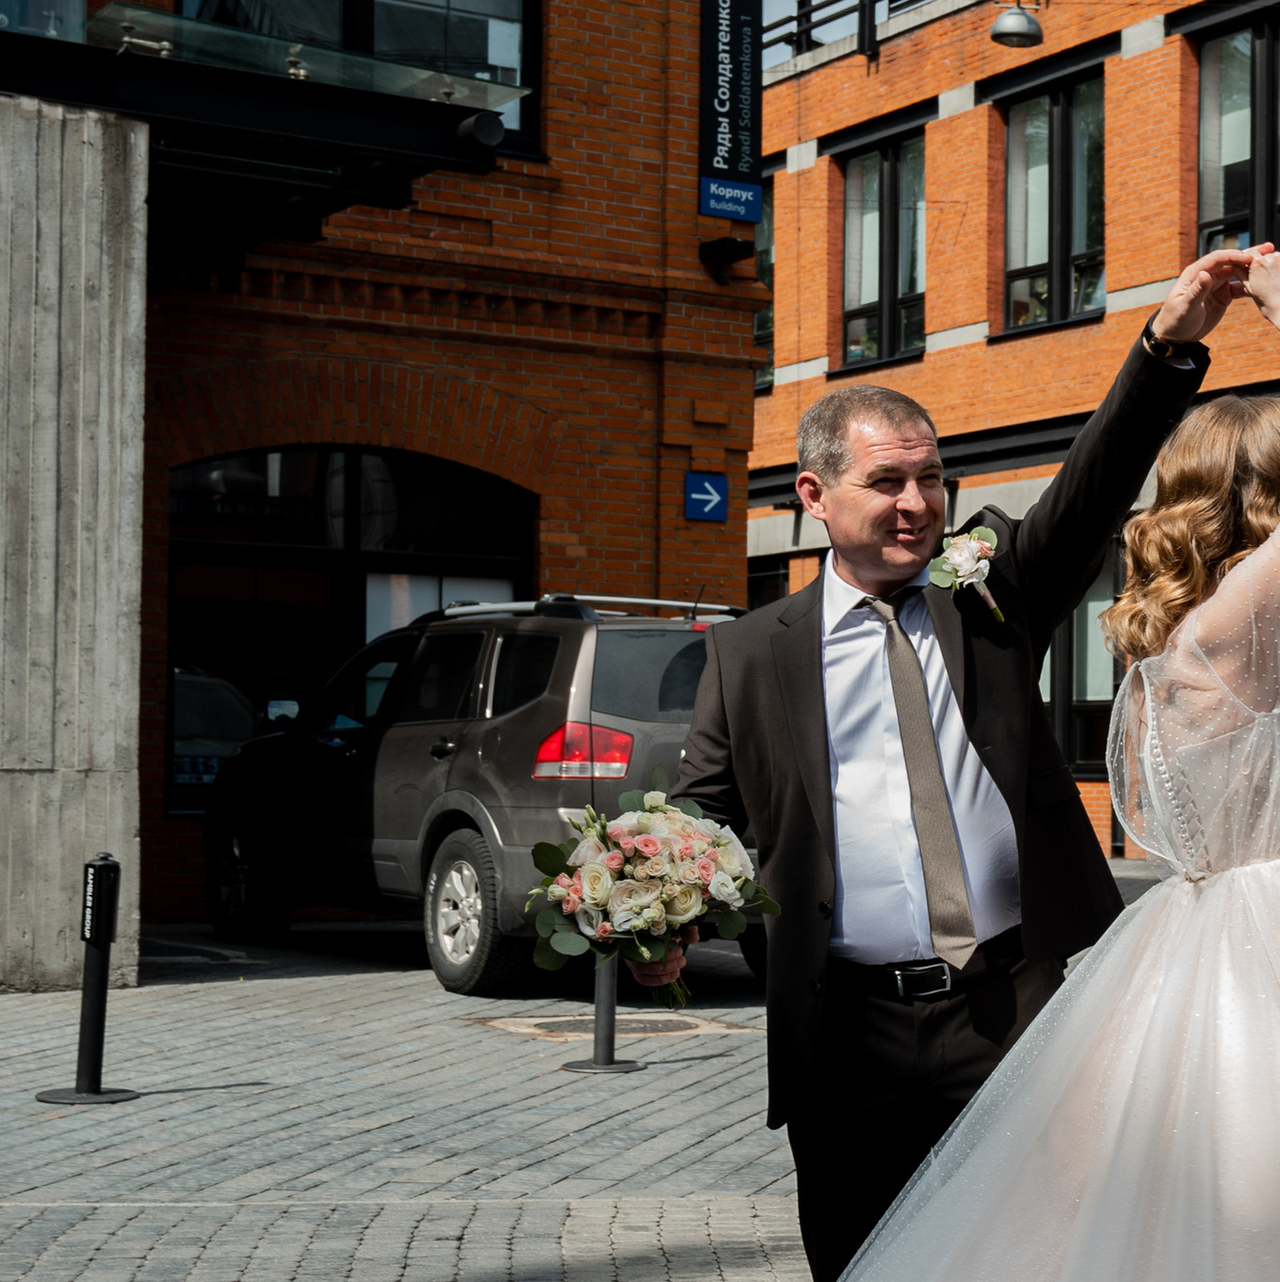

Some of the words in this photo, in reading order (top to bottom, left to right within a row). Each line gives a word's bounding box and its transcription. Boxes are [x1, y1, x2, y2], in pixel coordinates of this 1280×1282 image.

[738, 27, 752, 127] Soldatenkova
[713, 117, 732, 169] Ряды
[738, 130, 753, 172] Ryadi
[710, 183, 754, 201] Корпус
[710, 199, 745, 215] Building
[84, 908, 92, 938] GROUP
